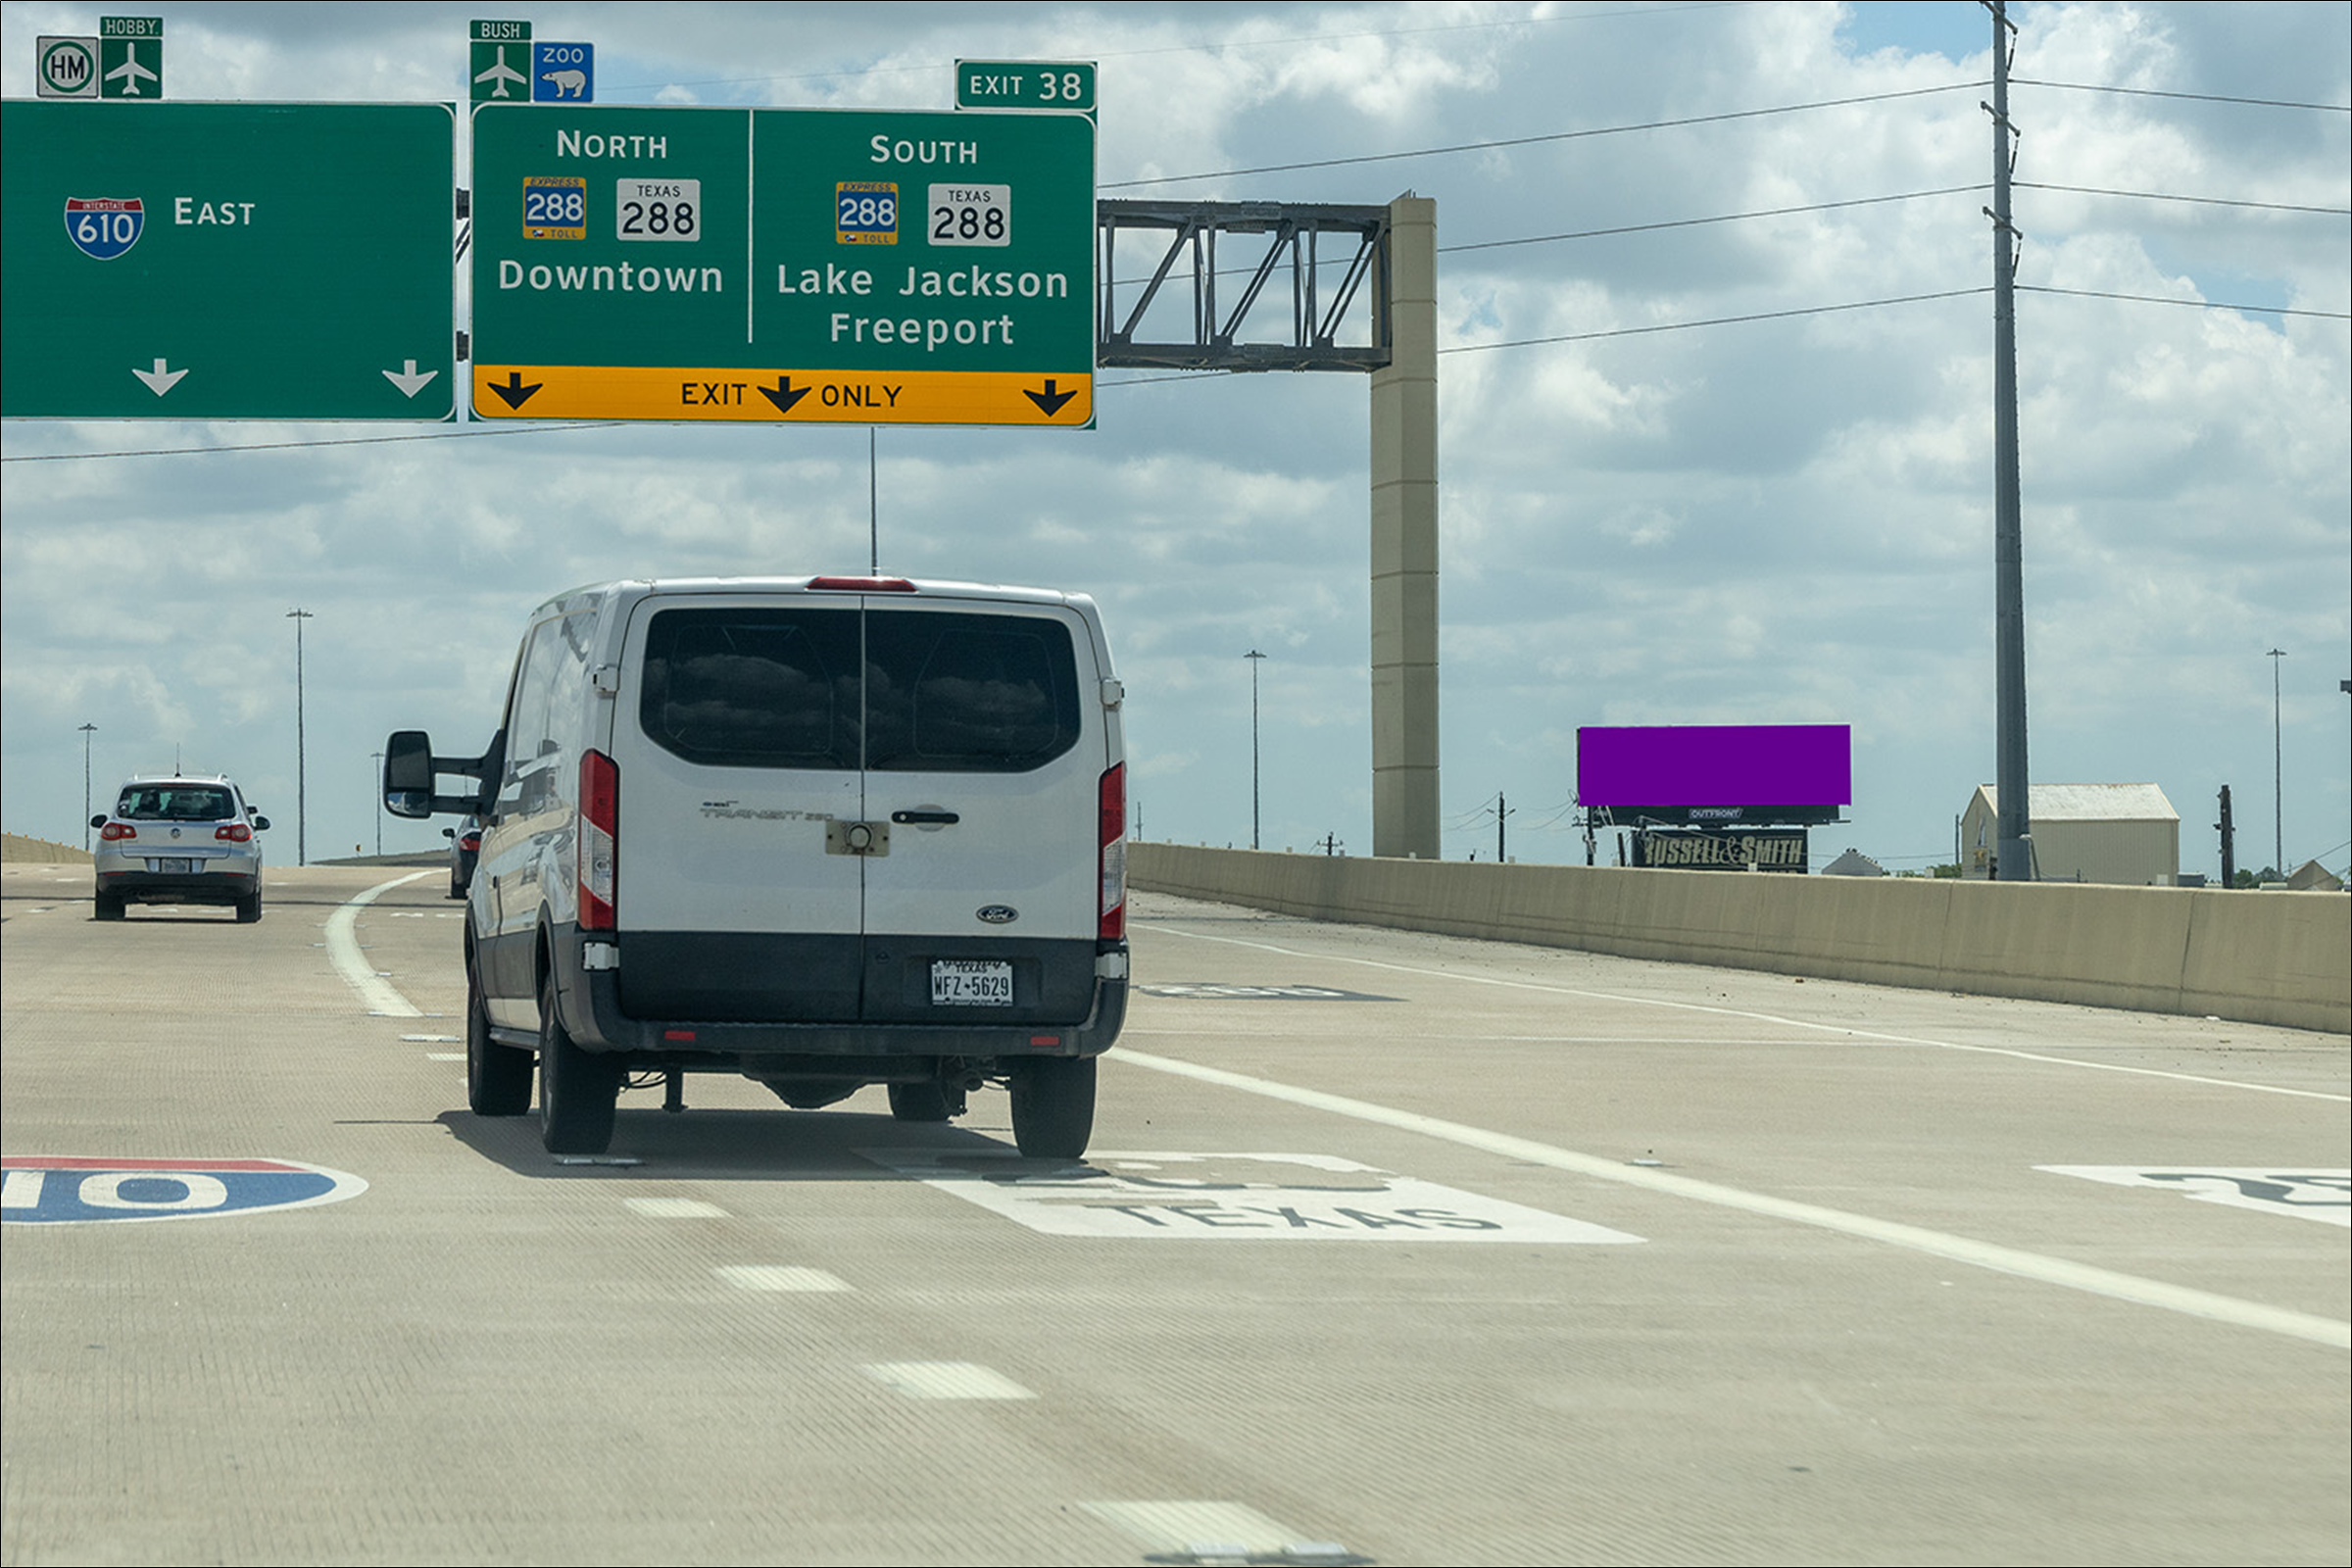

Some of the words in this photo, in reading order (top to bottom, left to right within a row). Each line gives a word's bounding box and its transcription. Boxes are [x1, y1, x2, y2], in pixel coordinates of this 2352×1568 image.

[105, 19, 156, 35] HOBBY
[481, 22, 521, 39] BUSH
[51, 55, 85, 79] HM
[542, 47, 585, 64] ZOO
[969, 75, 1023, 96] EXIT
[1038, 72, 1083, 101] 38
[557, 129, 667, 159] NORTH
[869, 134, 978, 165] SOUTH
[529, 177, 580, 187] EXPRESS
[637, 184, 681, 198] TEXAS
[843, 182, 892, 192] EXPRESS
[82, 199, 126, 211] INTERSTATE
[526, 192, 584, 221] 288
[948, 189, 992, 203] TEXAS
[173, 196, 256, 225] EAST
[622, 201, 695, 235] 288
[839, 197, 896, 226] 288
[933, 206, 1004, 240] 288
[76, 213, 134, 244] 610
[551, 228, 578, 239] TOLL
[863, 233, 890, 244] TOLL
[499, 259, 723, 292] Downtown
[777, 263, 873, 295] Lake
[899, 265, 1068, 298] Jackson
[831, 312, 1014, 352] Freeport
[681, 381, 748, 406] EXIT
[820, 384, 903, 408] ONLY
[1740, 836, 1803, 864] SMITH
[983, 906, 1012, 920] Ford
[1082, 1203, 1503, 1230] TEXAS
